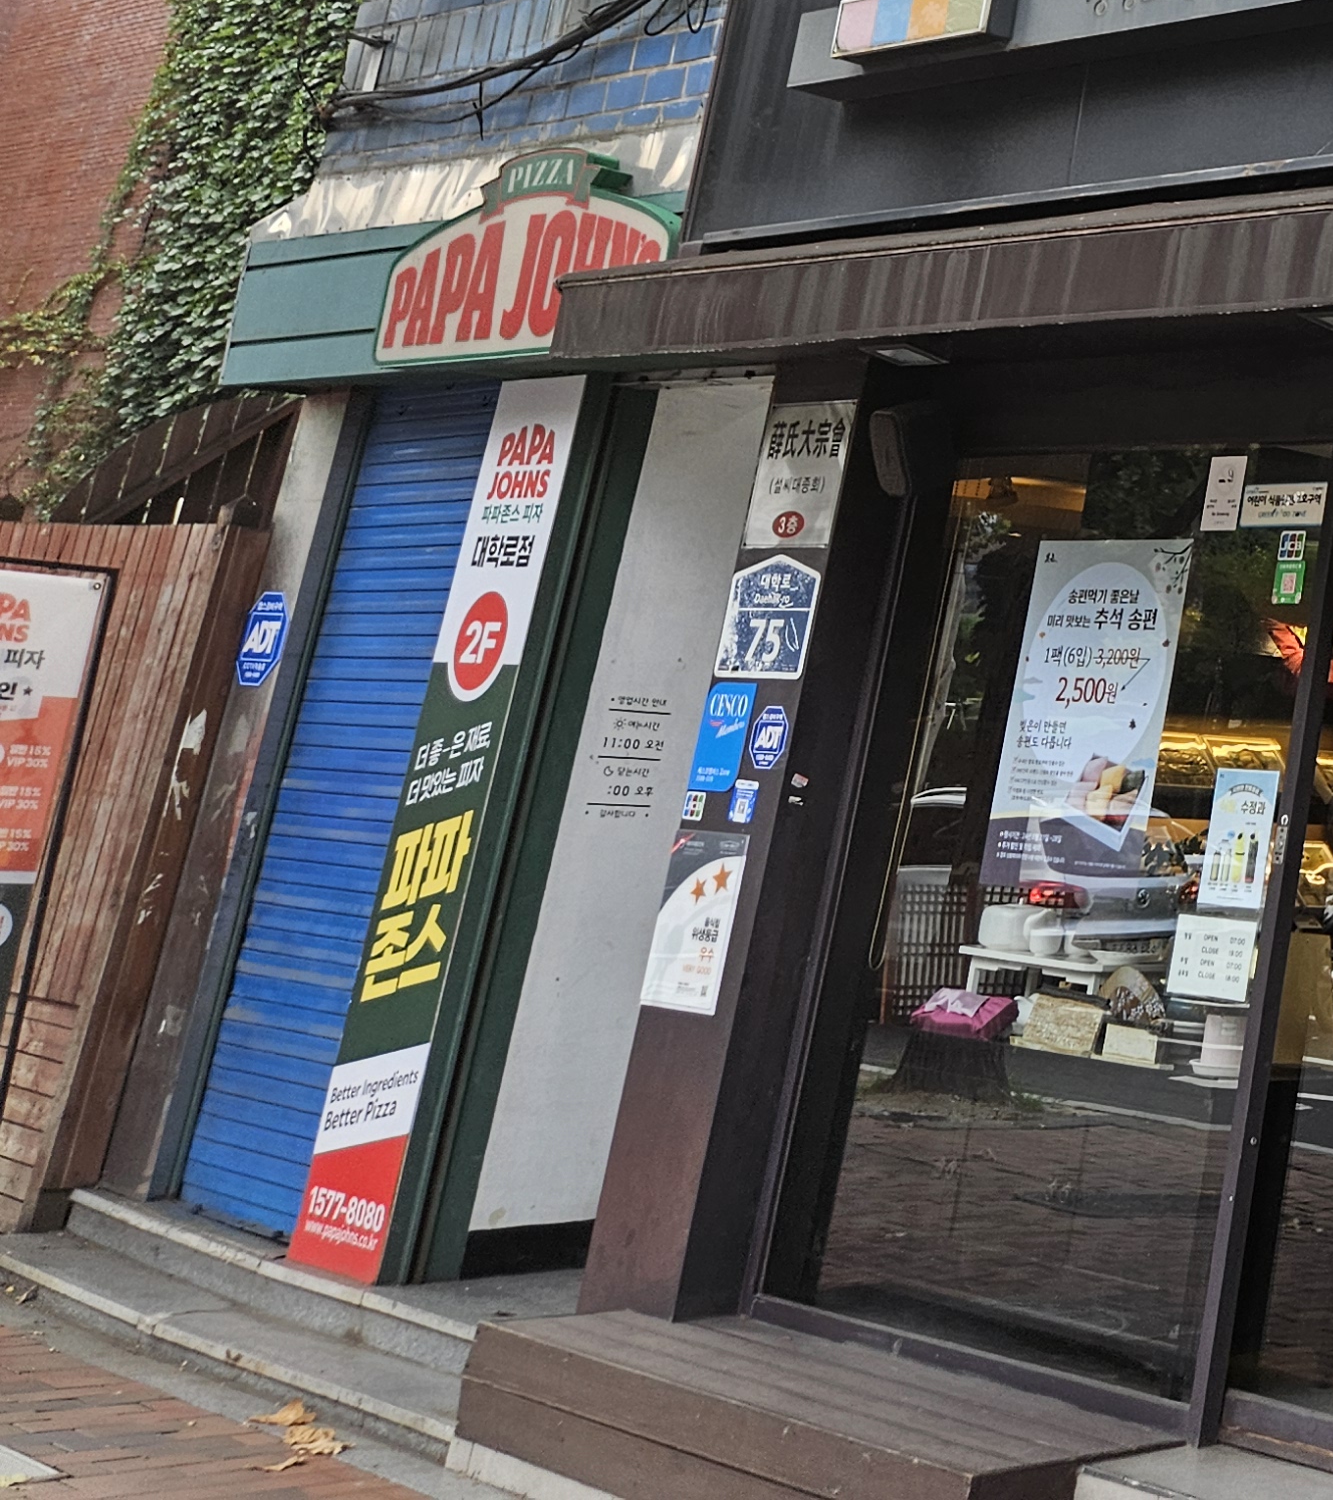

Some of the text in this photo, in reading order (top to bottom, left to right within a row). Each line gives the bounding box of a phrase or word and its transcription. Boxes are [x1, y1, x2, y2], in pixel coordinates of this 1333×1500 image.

[507, 158, 576, 193] PIZZA
[382, 220, 506, 349] PAPA
[497, 424, 555, 467] PAPA
[487, 469, 551, 500] JOHNS
[481, 503, 543, 524] 파파존스 피자
[778, 515, 799, 534] 3층
[471, 535, 536, 568] 대학로점
[1280, 541, 1302, 550] JCB
[761, 573, 792, 591] 대학로
[1068, 589, 1139, 604] 송편먹기 좋은날
[1047, 607, 1158, 631] 미리 맛보는 추석 송편
[242, 620, 282, 654] ADT
[459, 621, 502, 665] 2F
[744, 619, 785, 662] 75
[4, 648, 45, 670] 피자
[1044, 646, 1141, 669] 1팩(6입) 3,200원
[618, 695, 668, 707] 영업시간 안내
[1055, 677, 1118, 709] 2,500원
[710, 693, 748, 717] CESCO
[628, 721, 660, 731] 여는시간
[754, 725, 784, 749] ADT
[603, 736, 664, 751] 11:00 오전
[1016, 736, 1039, 749] 송편도
[7, 757, 49, 769] VIP 30%
[414, 743, 430, 771] 더
[405, 756, 484, 806] 더 맛있는 피자
[617, 766, 650, 778] 닫는시간
[634, 786, 654, 797] 오후
[600, 809, 636, 818] 감사합니다
[1240, 800, 1267, 816] 수정과
[381, 810, 474, 910] 파파
[692, 928, 719, 943] 위생등급
[1204, 934, 1219, 942] OPEN
[360, 904, 446, 1002] 존스
[699, 947, 714, 963] 우수
[330, 1070, 419, 1104] Better Ingredients
[324, 1098, 397, 1131] Better Pizza
[309, 1186, 385, 1233] 1577-8080
